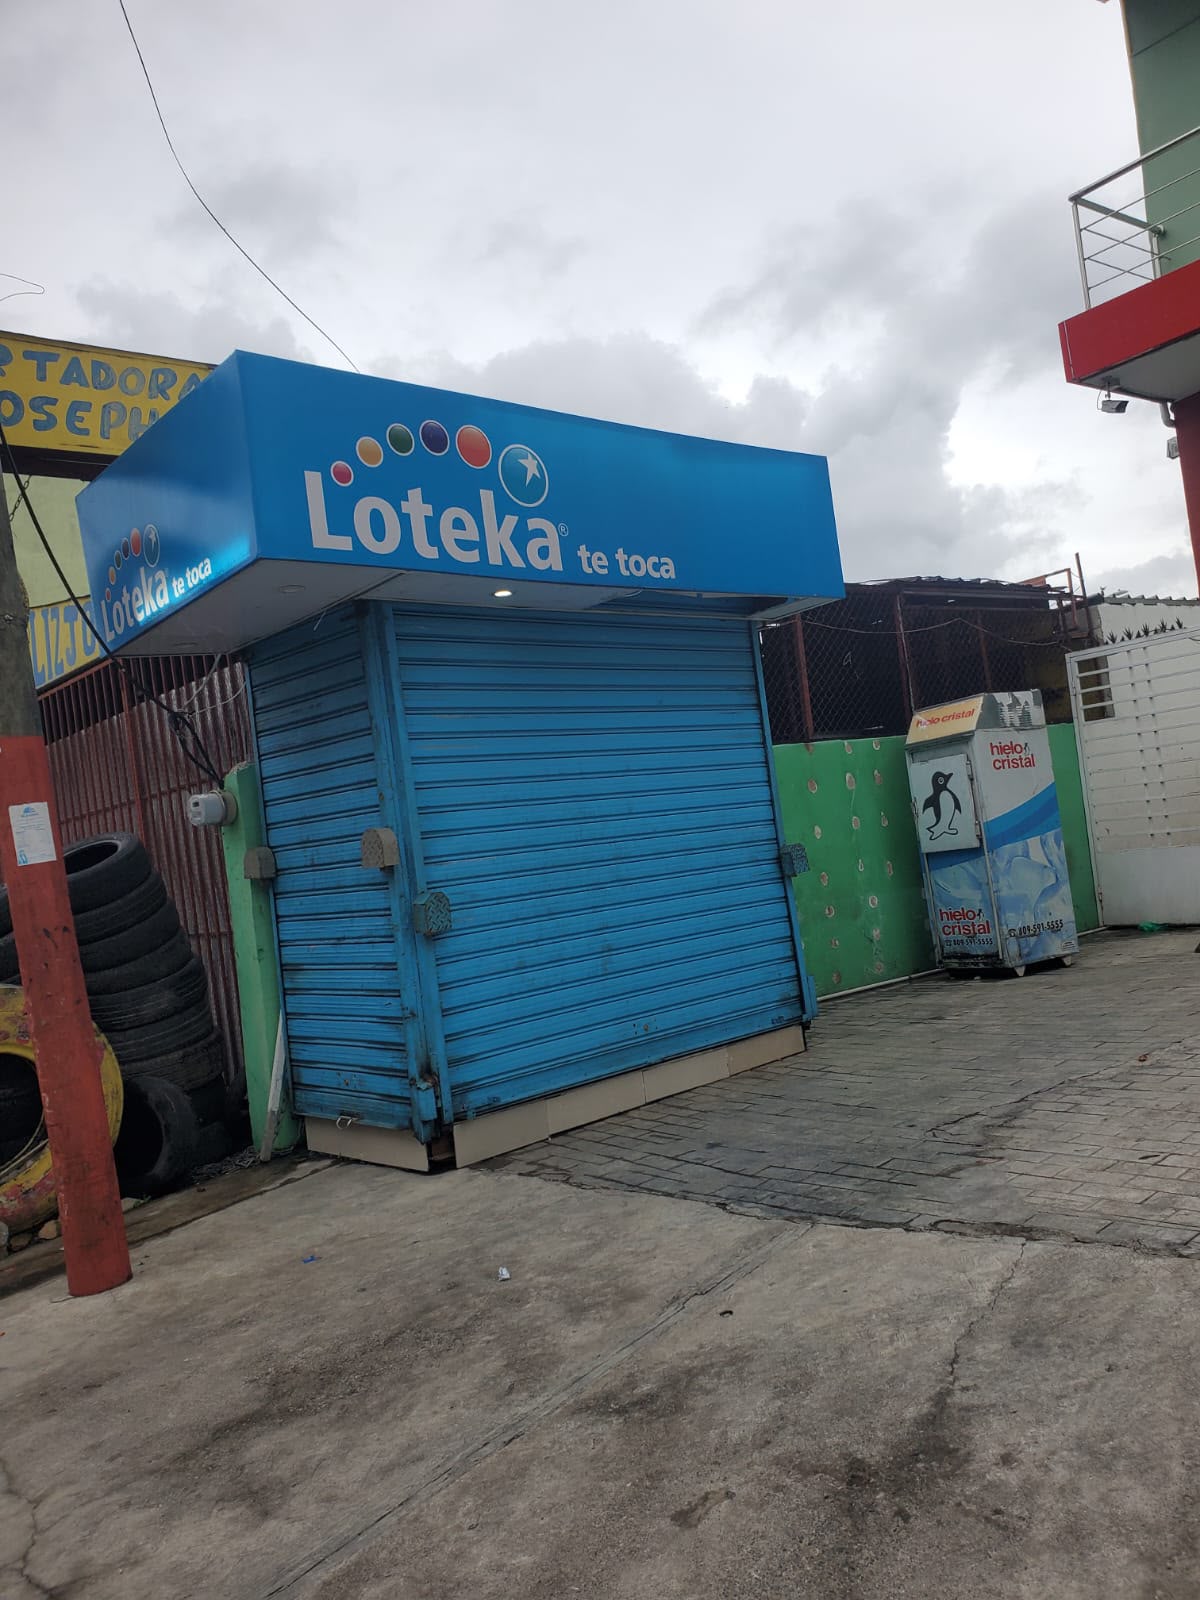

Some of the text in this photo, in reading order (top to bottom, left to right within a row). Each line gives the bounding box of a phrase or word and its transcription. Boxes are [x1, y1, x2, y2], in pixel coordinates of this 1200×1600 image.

[304, 470, 676, 579] Loteka te toca
[101, 558, 212, 642] Loteka te toca
[941, 708, 975, 723] cristal
[990, 741, 1023, 756] hielo
[993, 754, 1036, 770] cristal
[939, 907, 977, 921] hielo
[942, 920, 991, 936] cristal
[1018, 919, 1064, 936] 809-591-5555
